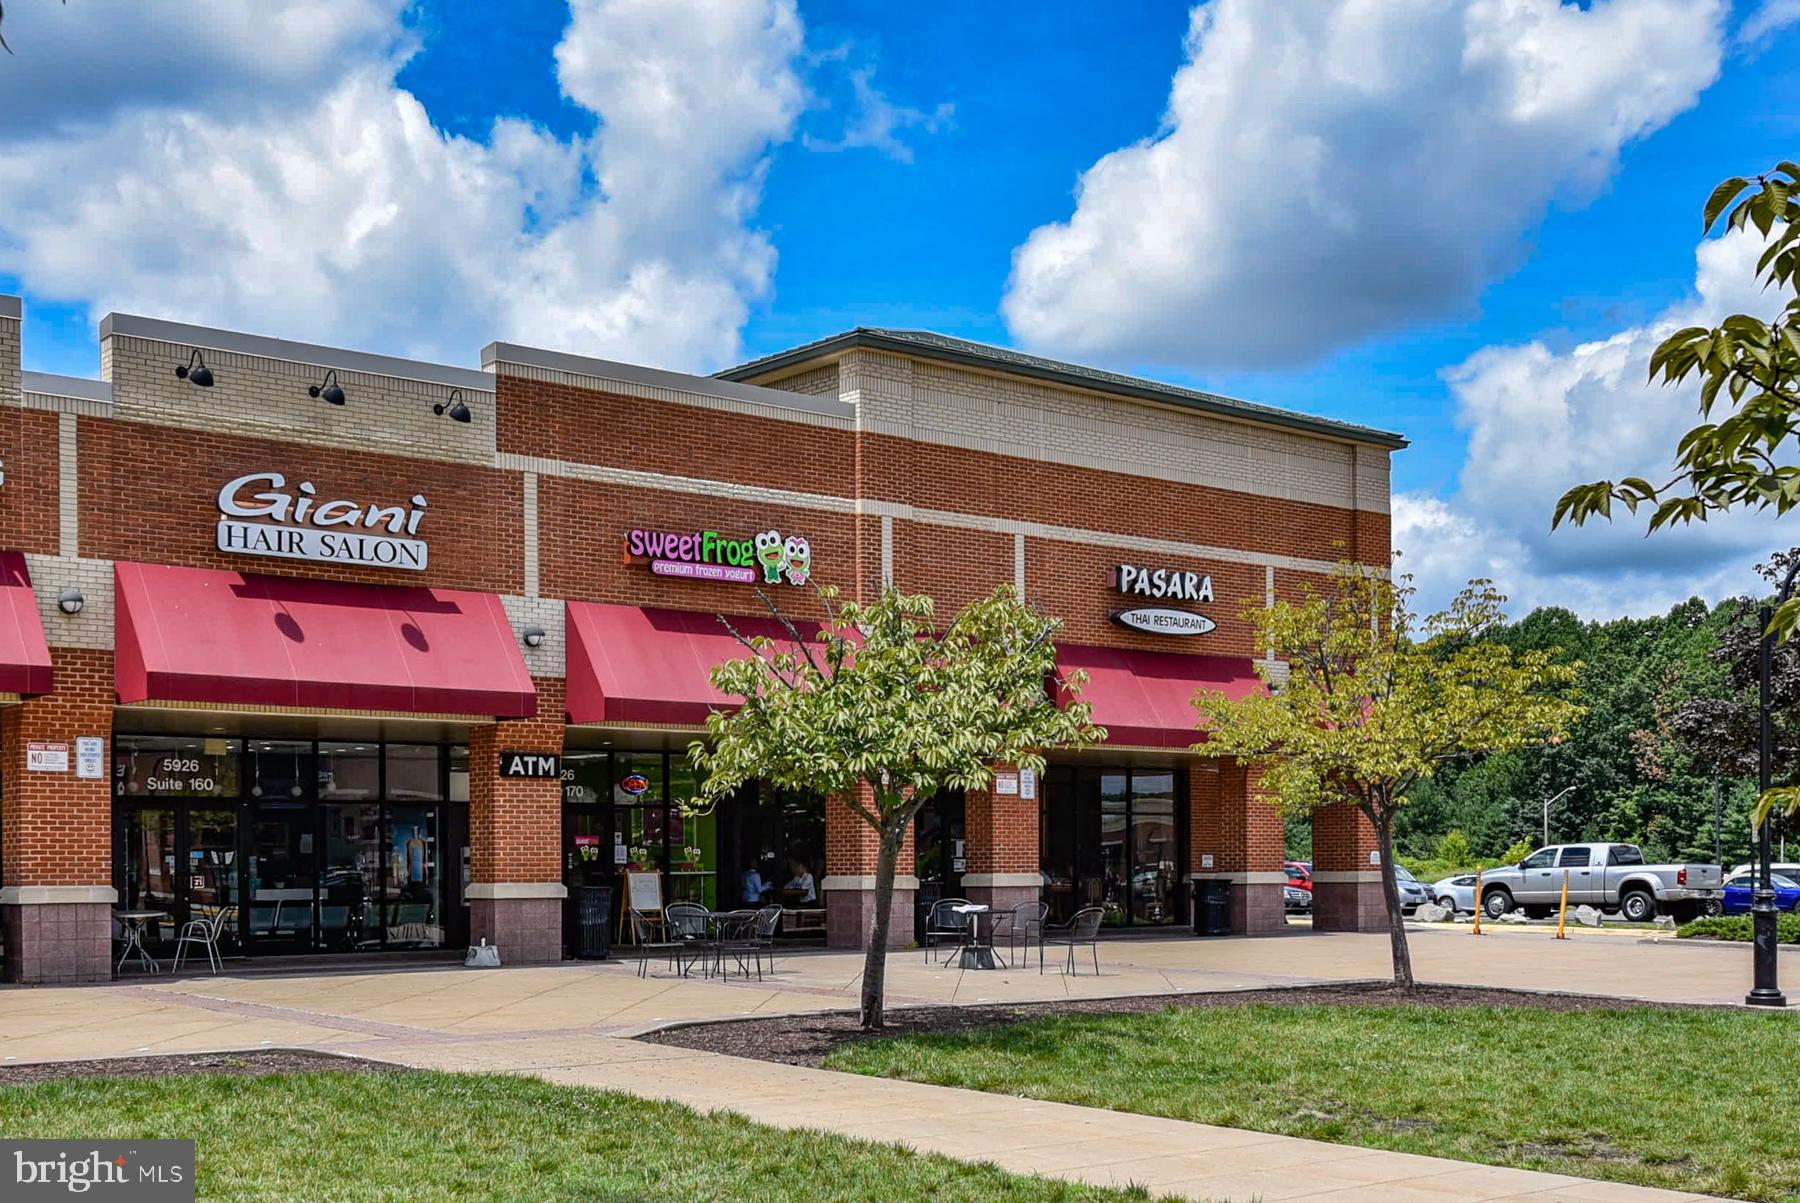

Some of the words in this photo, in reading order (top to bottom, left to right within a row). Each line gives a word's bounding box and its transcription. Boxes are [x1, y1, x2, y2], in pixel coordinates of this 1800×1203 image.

[218, 472, 427, 535] Giani
[225, 524, 308, 556] HAIR
[319, 534, 421, 566] SALON
[630, 529, 755, 567] sweetFrog
[654, 562, 694, 575] premium
[695, 566, 722, 577] frozen
[724, 569, 754, 582] yogurt
[1120, 564, 1215, 602] PASARA
[1130, 612, 1151, 624] THAI
[1153, 615, 1207, 630] RESTAURANT
[31, 752, 43, 764] NO
[163, 758, 200, 772] 5926
[508, 755, 556, 776] ATM
[146, 776, 184, 790] Suite
[188, 778, 214, 791] 160
[566, 785, 584, 797] 170
